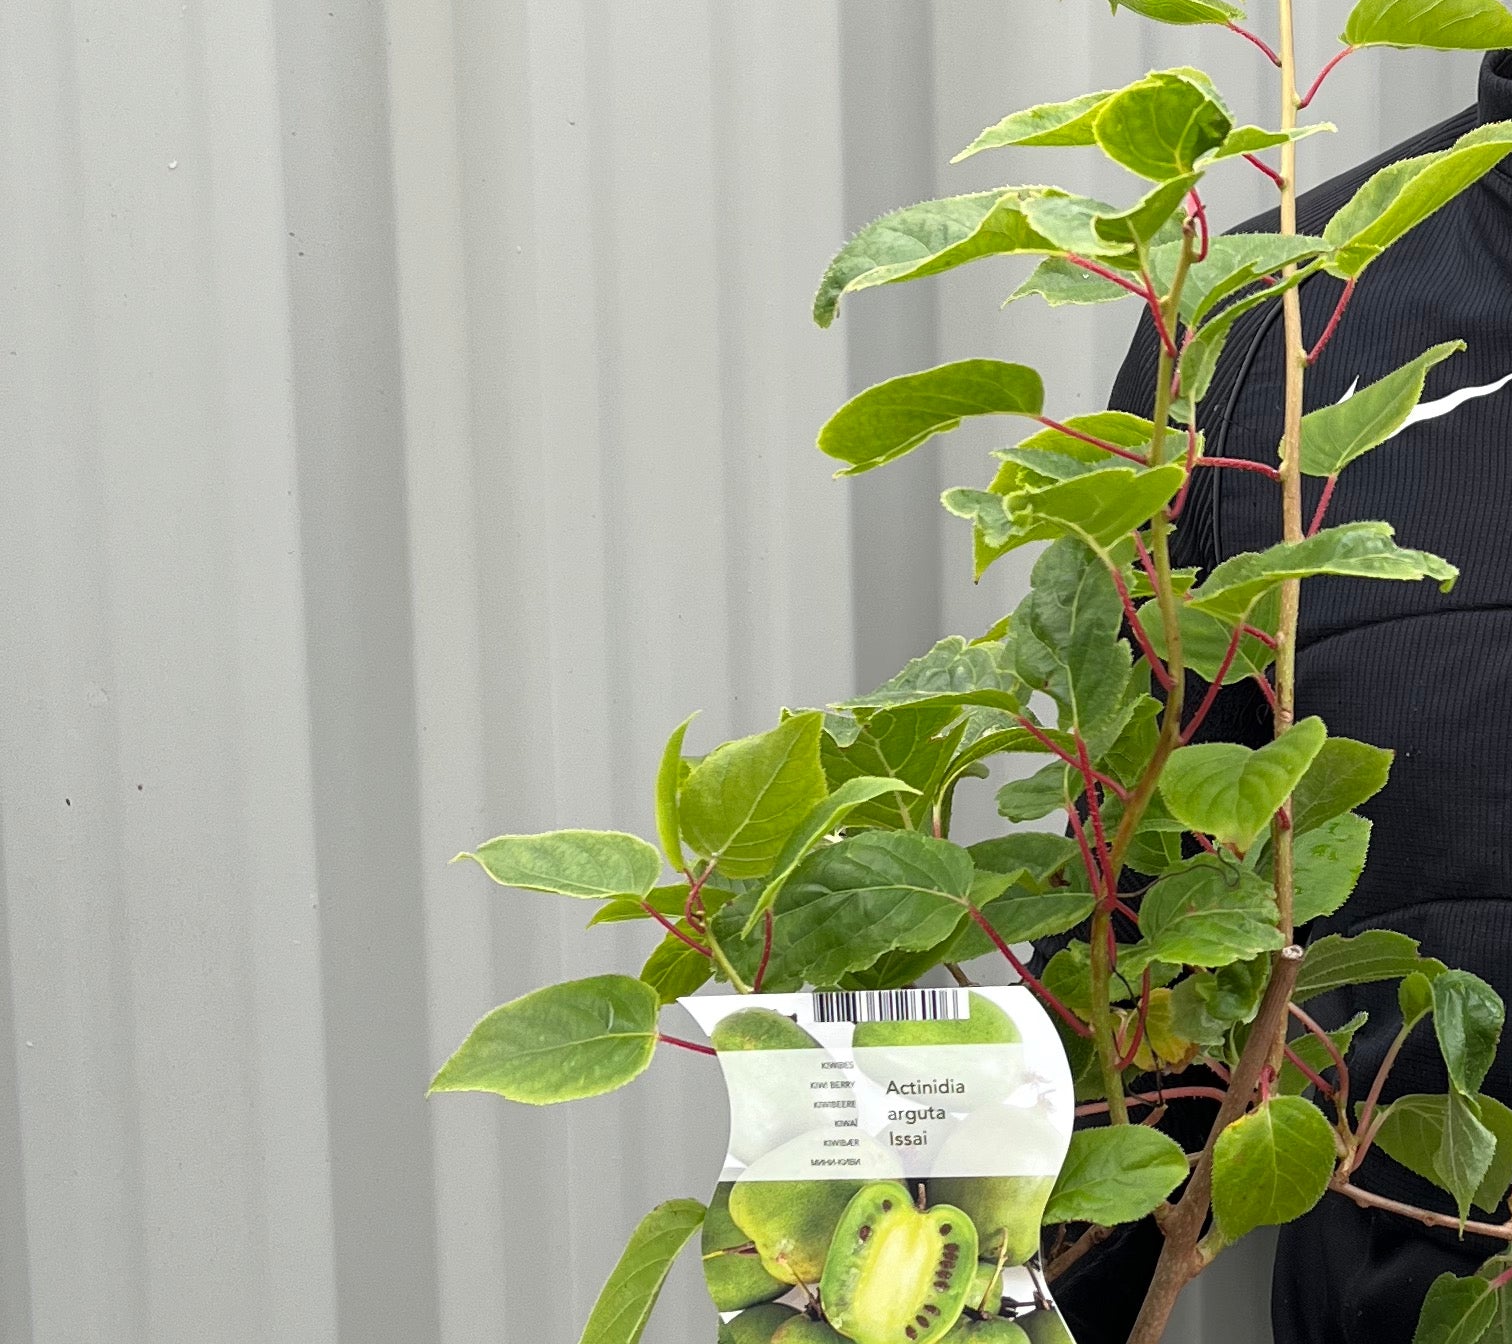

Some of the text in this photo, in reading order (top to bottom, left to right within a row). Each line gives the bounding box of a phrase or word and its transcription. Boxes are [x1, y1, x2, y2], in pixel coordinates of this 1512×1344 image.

[830, 1080, 856, 1090] BERRY
[886, 1078, 965, 1095] Actinidia
[888, 1106, 946, 1124] arguta
[889, 1130, 927, 1146] Issai
